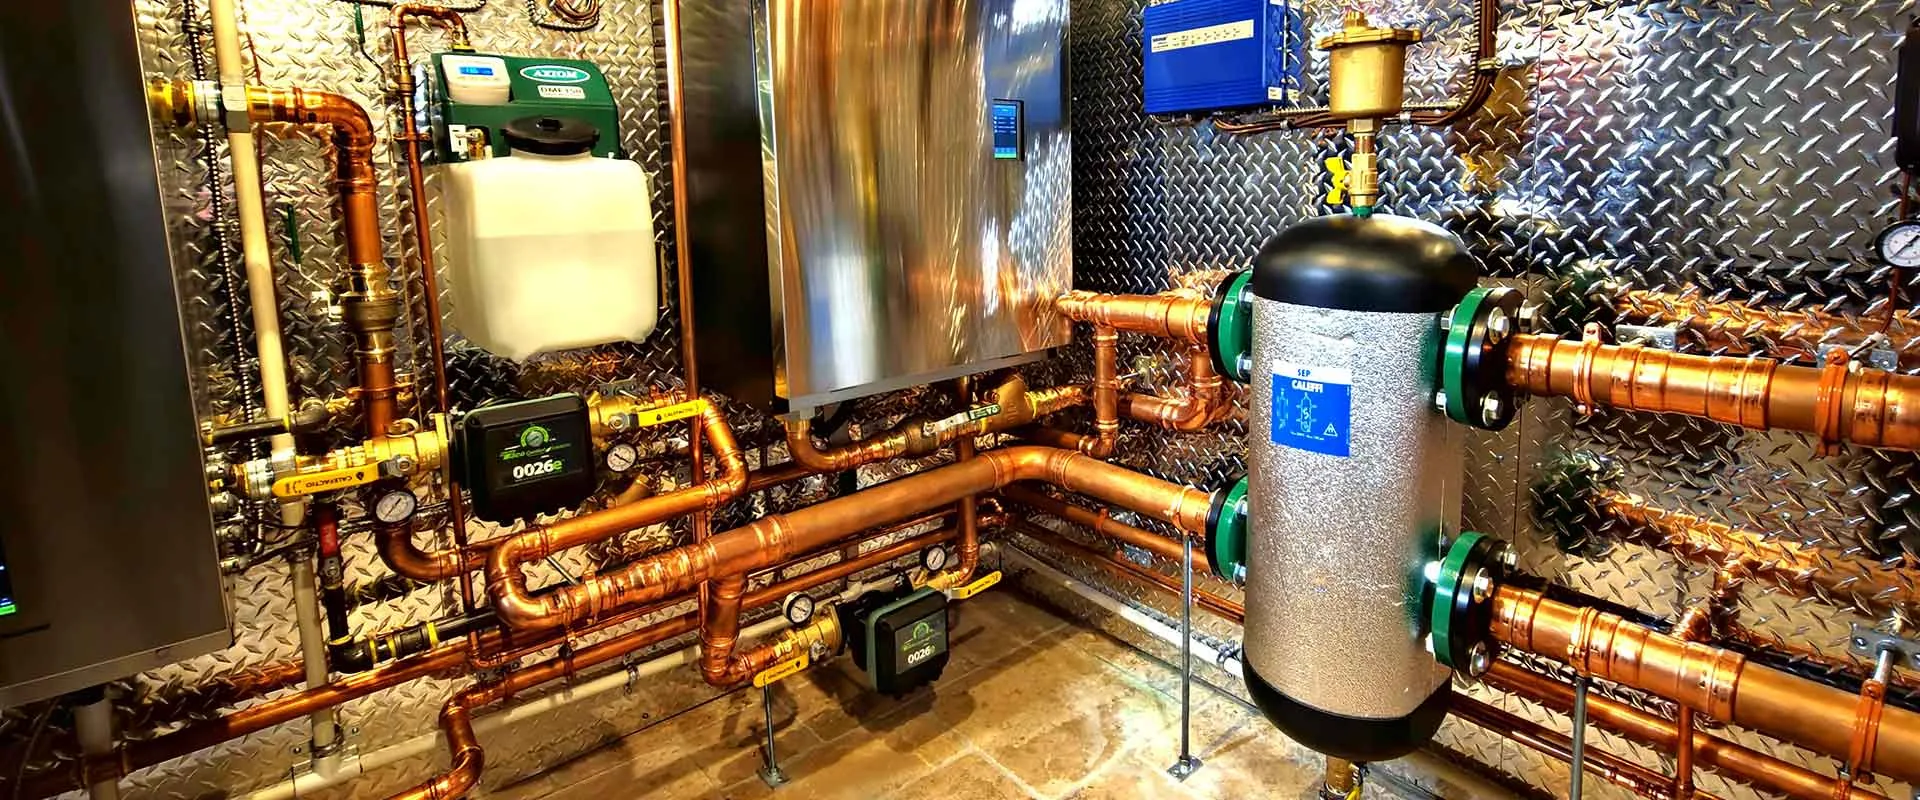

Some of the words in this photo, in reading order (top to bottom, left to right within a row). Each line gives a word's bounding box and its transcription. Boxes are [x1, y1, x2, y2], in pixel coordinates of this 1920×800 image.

[533, 69, 577, 78] AXIOM
[1297, 368, 1311, 377] SEP
[1291, 379, 1324, 394] CALEFFI
[512, 459, 563, 479] 0026e
